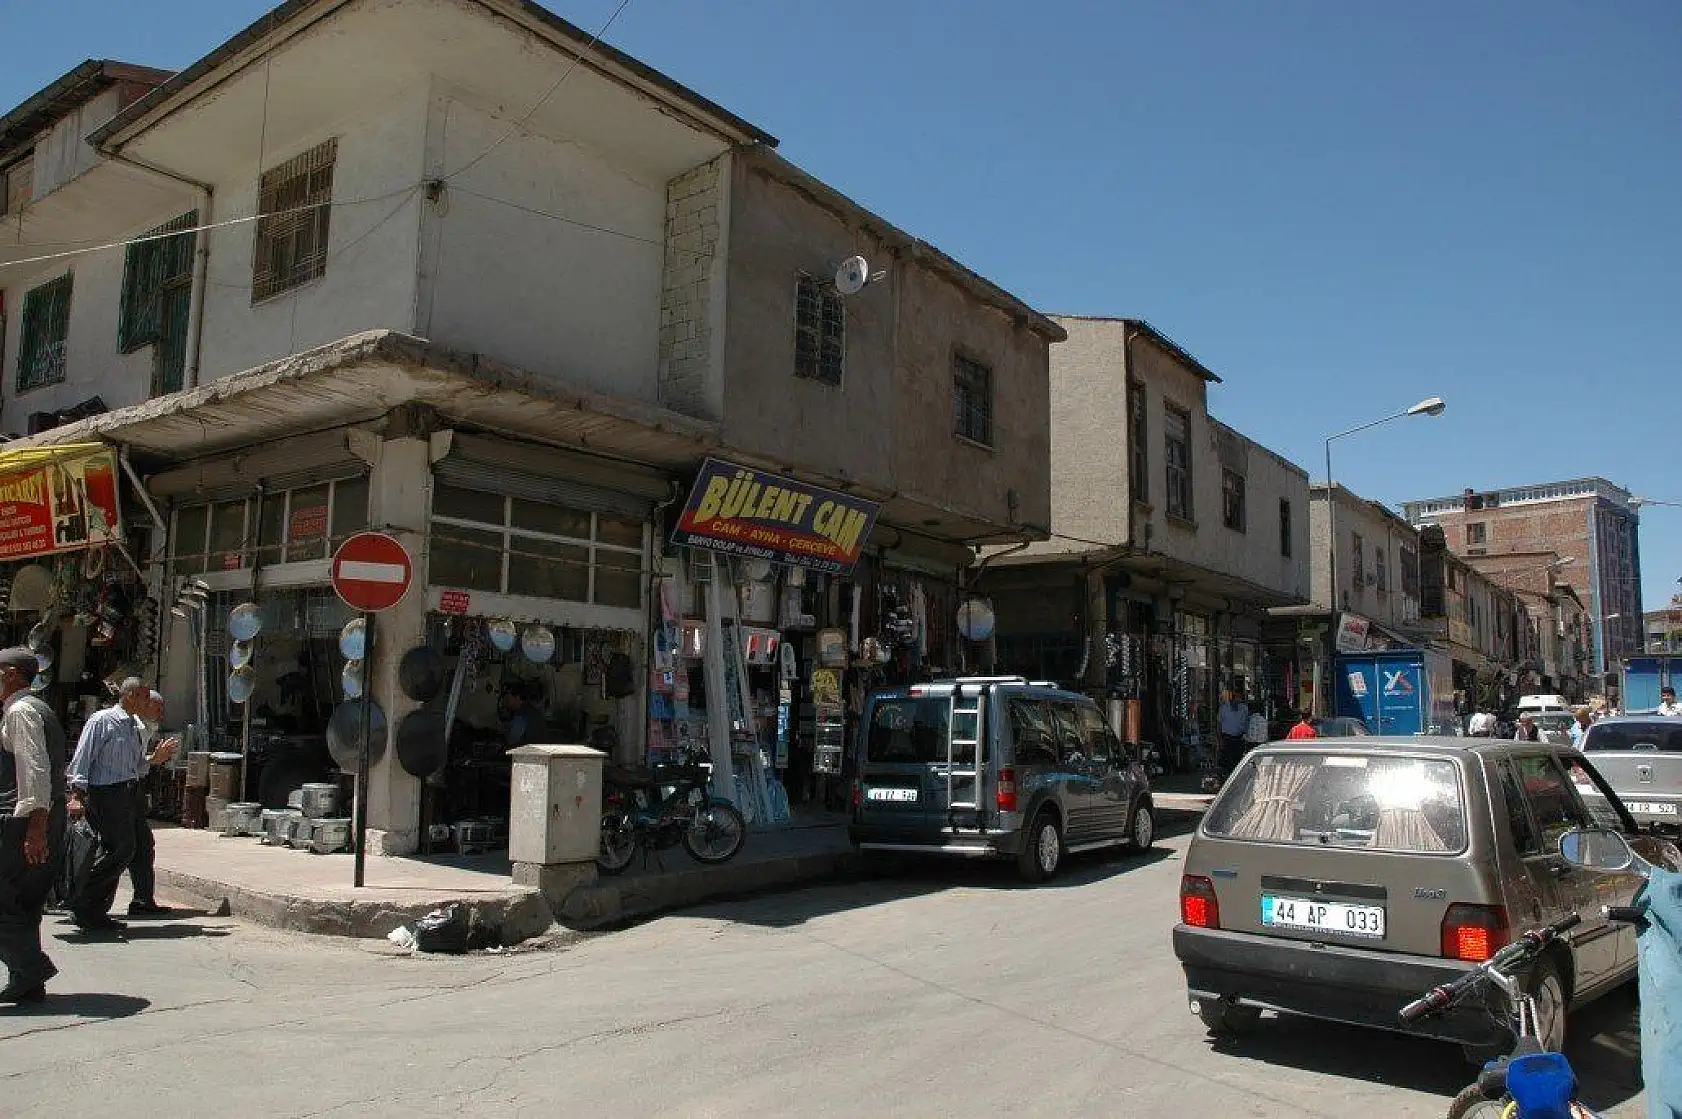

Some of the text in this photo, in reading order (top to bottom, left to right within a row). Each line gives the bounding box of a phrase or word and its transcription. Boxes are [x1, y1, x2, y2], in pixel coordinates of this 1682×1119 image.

[693, 470, 868, 557] BÜLENT CAM
[712, 521, 741, 536] CAM
[751, 529, 780, 545] AYNA
[1276, 901, 1295, 921] 44
[1307, 905, 1327, 926] AP
[1346, 909, 1379, 932] 033
